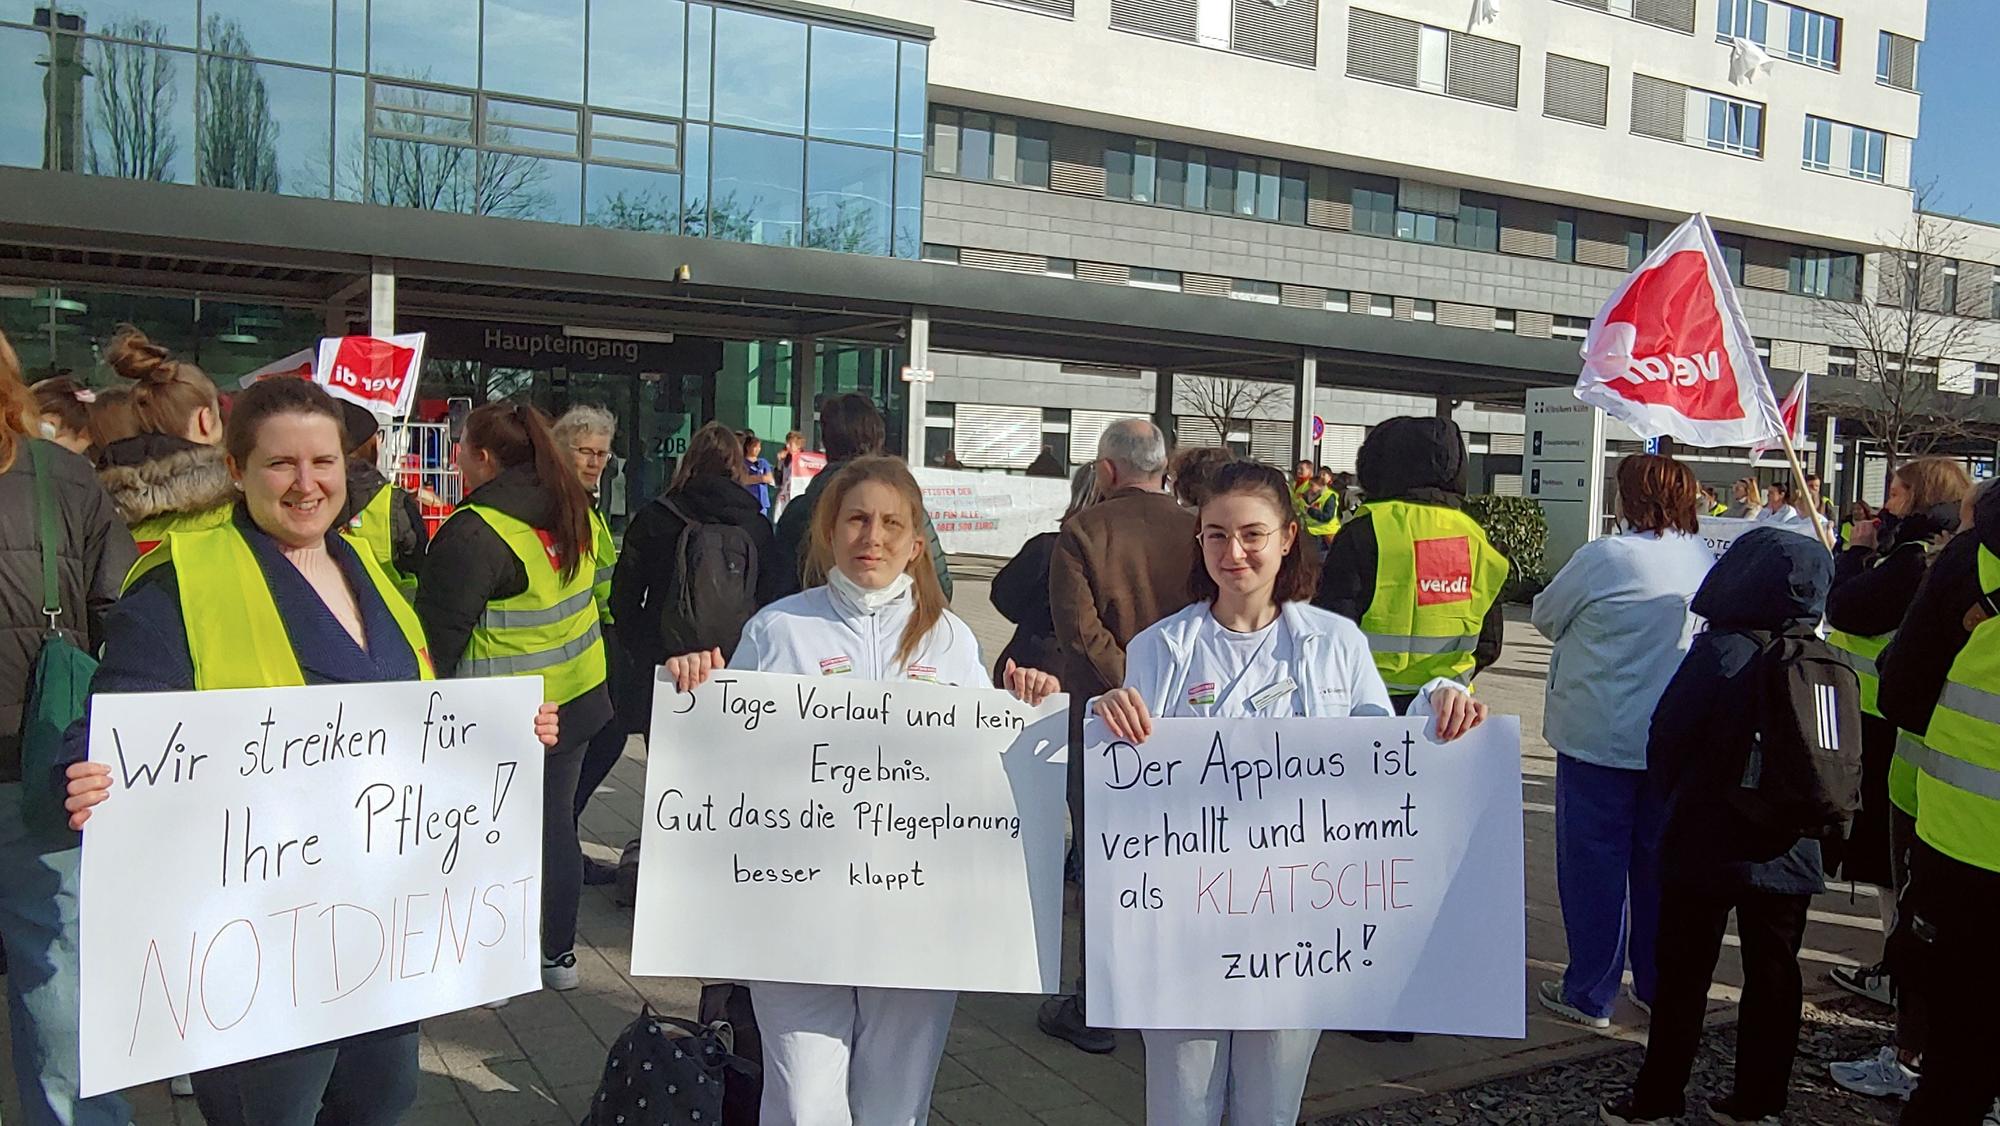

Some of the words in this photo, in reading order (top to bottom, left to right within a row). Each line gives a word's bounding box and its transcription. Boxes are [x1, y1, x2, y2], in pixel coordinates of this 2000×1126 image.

[484, 328, 639, 362] Haupteingang
[653, 436, 686, 454] 20B
[1420, 575, 1468, 593] ver.di
[714, 679, 778, 731] Tage
[796, 682, 892, 721] Vorlauf
[906, 706, 957, 729] und
[975, 700, 1026, 732] kein
[112, 721, 208, 790] Wir
[239, 701, 387, 778] streiken
[421, 691, 477, 764] für
[1101, 740, 1183, 791] Der
[1199, 730, 1346, 802] Applaus
[1372, 730, 1418, 778] ist
[810, 743, 931, 794] Ergebnis.
[222, 806, 322, 887] Ihre
[354, 761, 518, 875] Pflege!
[655, 788, 718, 833] Gut
[727, 792, 792, 830] dass
[799, 800, 836, 830] die
[853, 801, 1022, 841] Pflegeplanung
[1100, 806, 1231, 861] verhallt
[1247, 798, 1306, 850] und
[1321, 792, 1419, 844] kommt
[733, 853, 822, 885] besser
[848, 860, 926, 892] klappt
[1119, 871, 1165, 911] als
[1196, 857, 1415, 916] KLATSCHE
[128, 875, 536, 1057] NOTDIENST
[1220, 923, 1378, 981] zurück!
